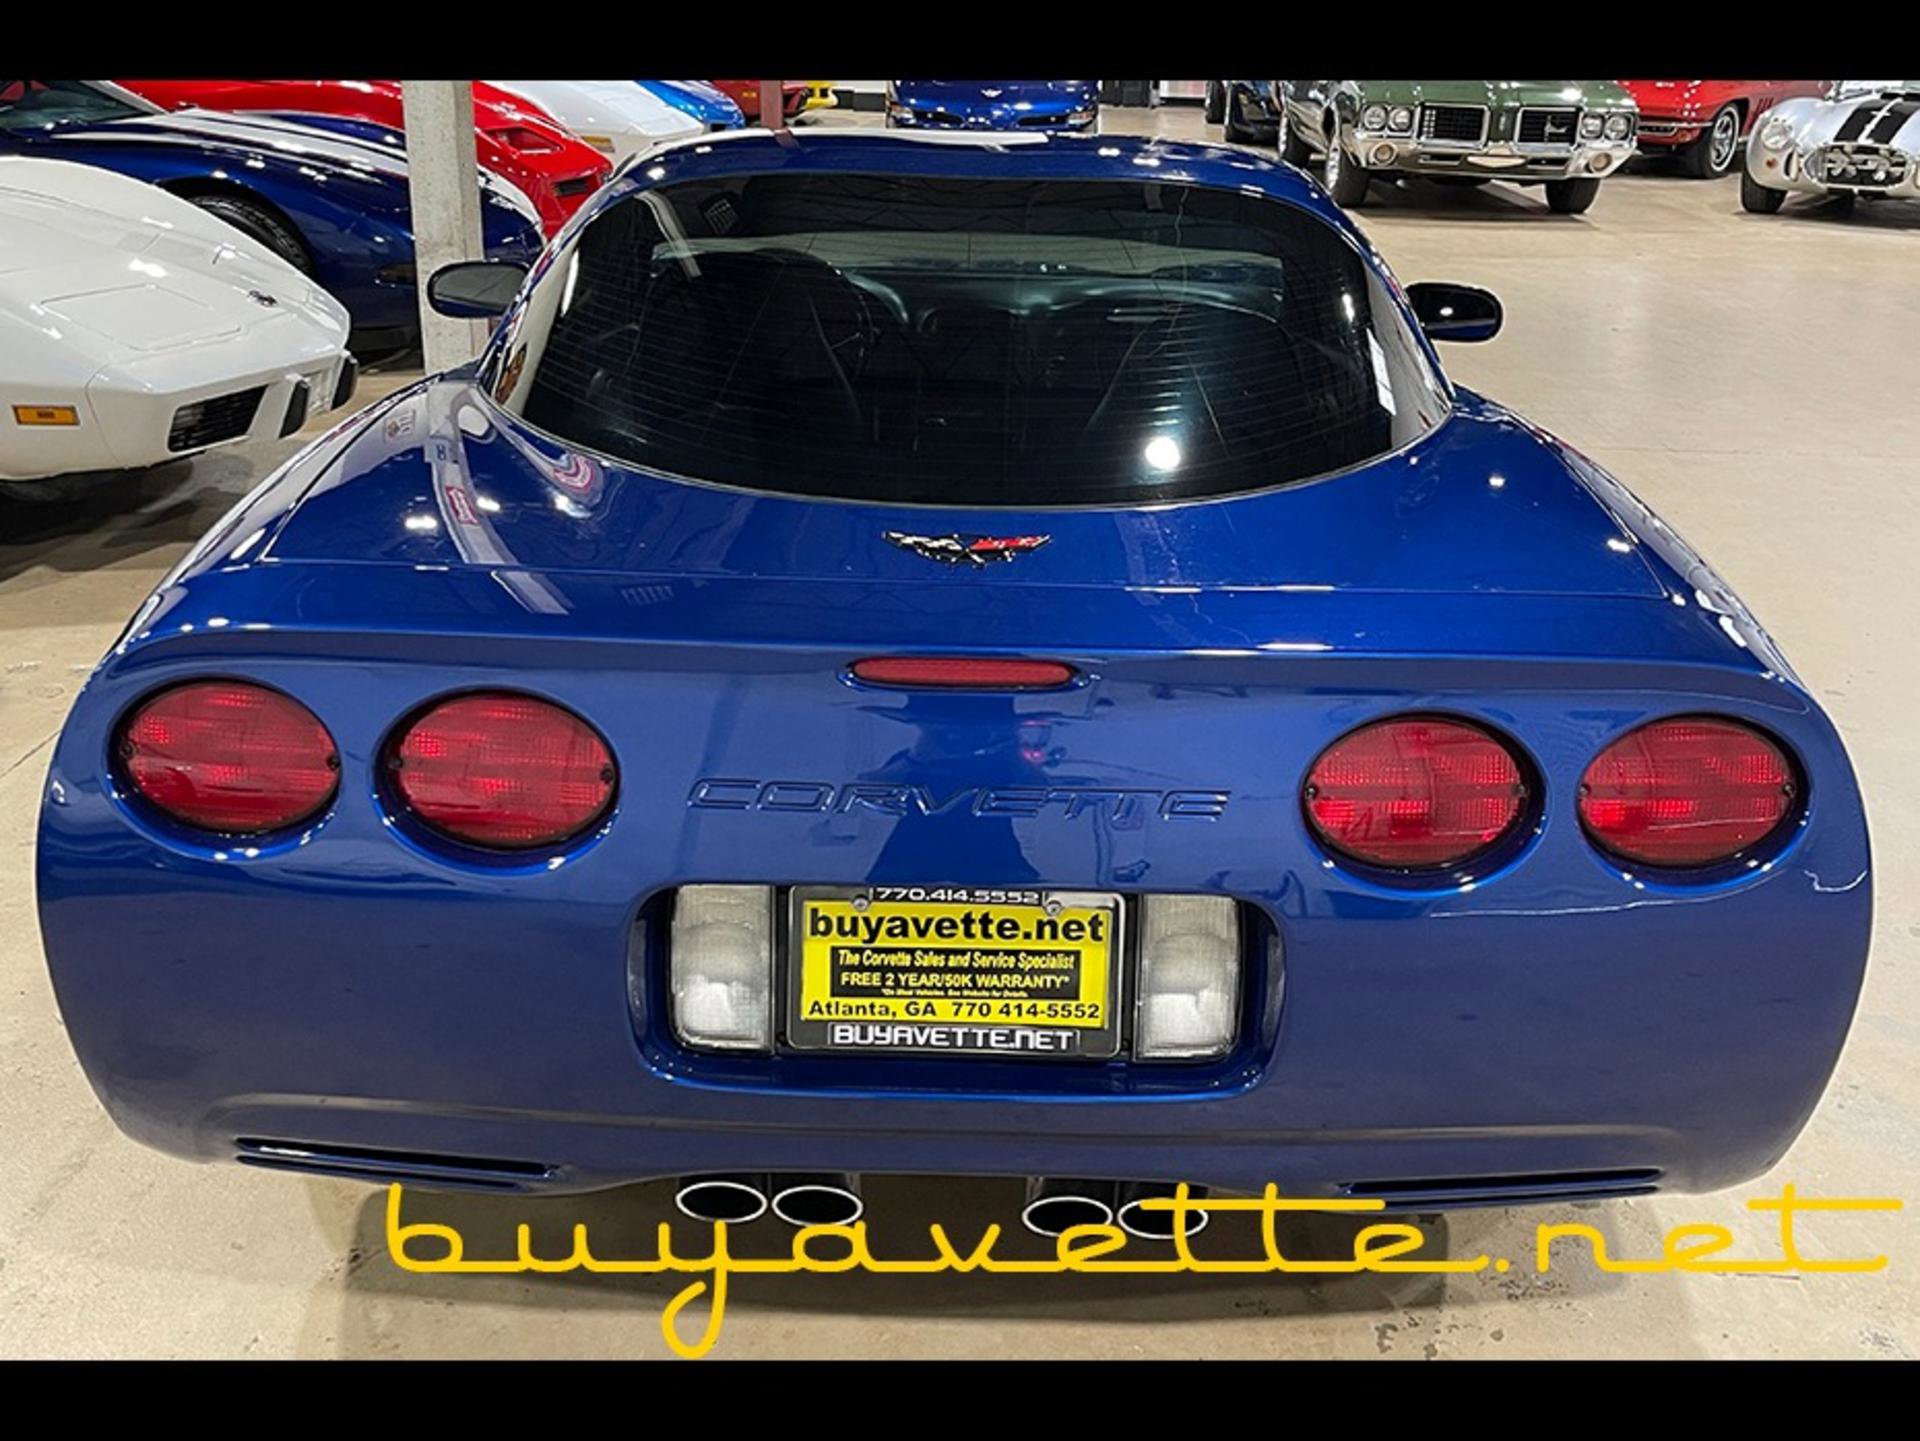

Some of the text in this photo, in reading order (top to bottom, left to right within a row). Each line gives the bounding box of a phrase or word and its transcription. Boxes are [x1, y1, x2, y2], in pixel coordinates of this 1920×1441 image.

[687, 777, 1230, 822] CORVETTE
[876, 887, 1040, 905] 770.414.5552
[809, 907, 1104, 944] buyavette.net
[838, 949, 1075, 972] The Corvette Sales and Service Specialist
[841, 971, 882, 986] FREE
[884, 972, 895, 986] 2
[898, 972, 974, 988] YEAR/50K
[809, 1000, 1100, 1019] Atlanta, GA 770 414-5552
